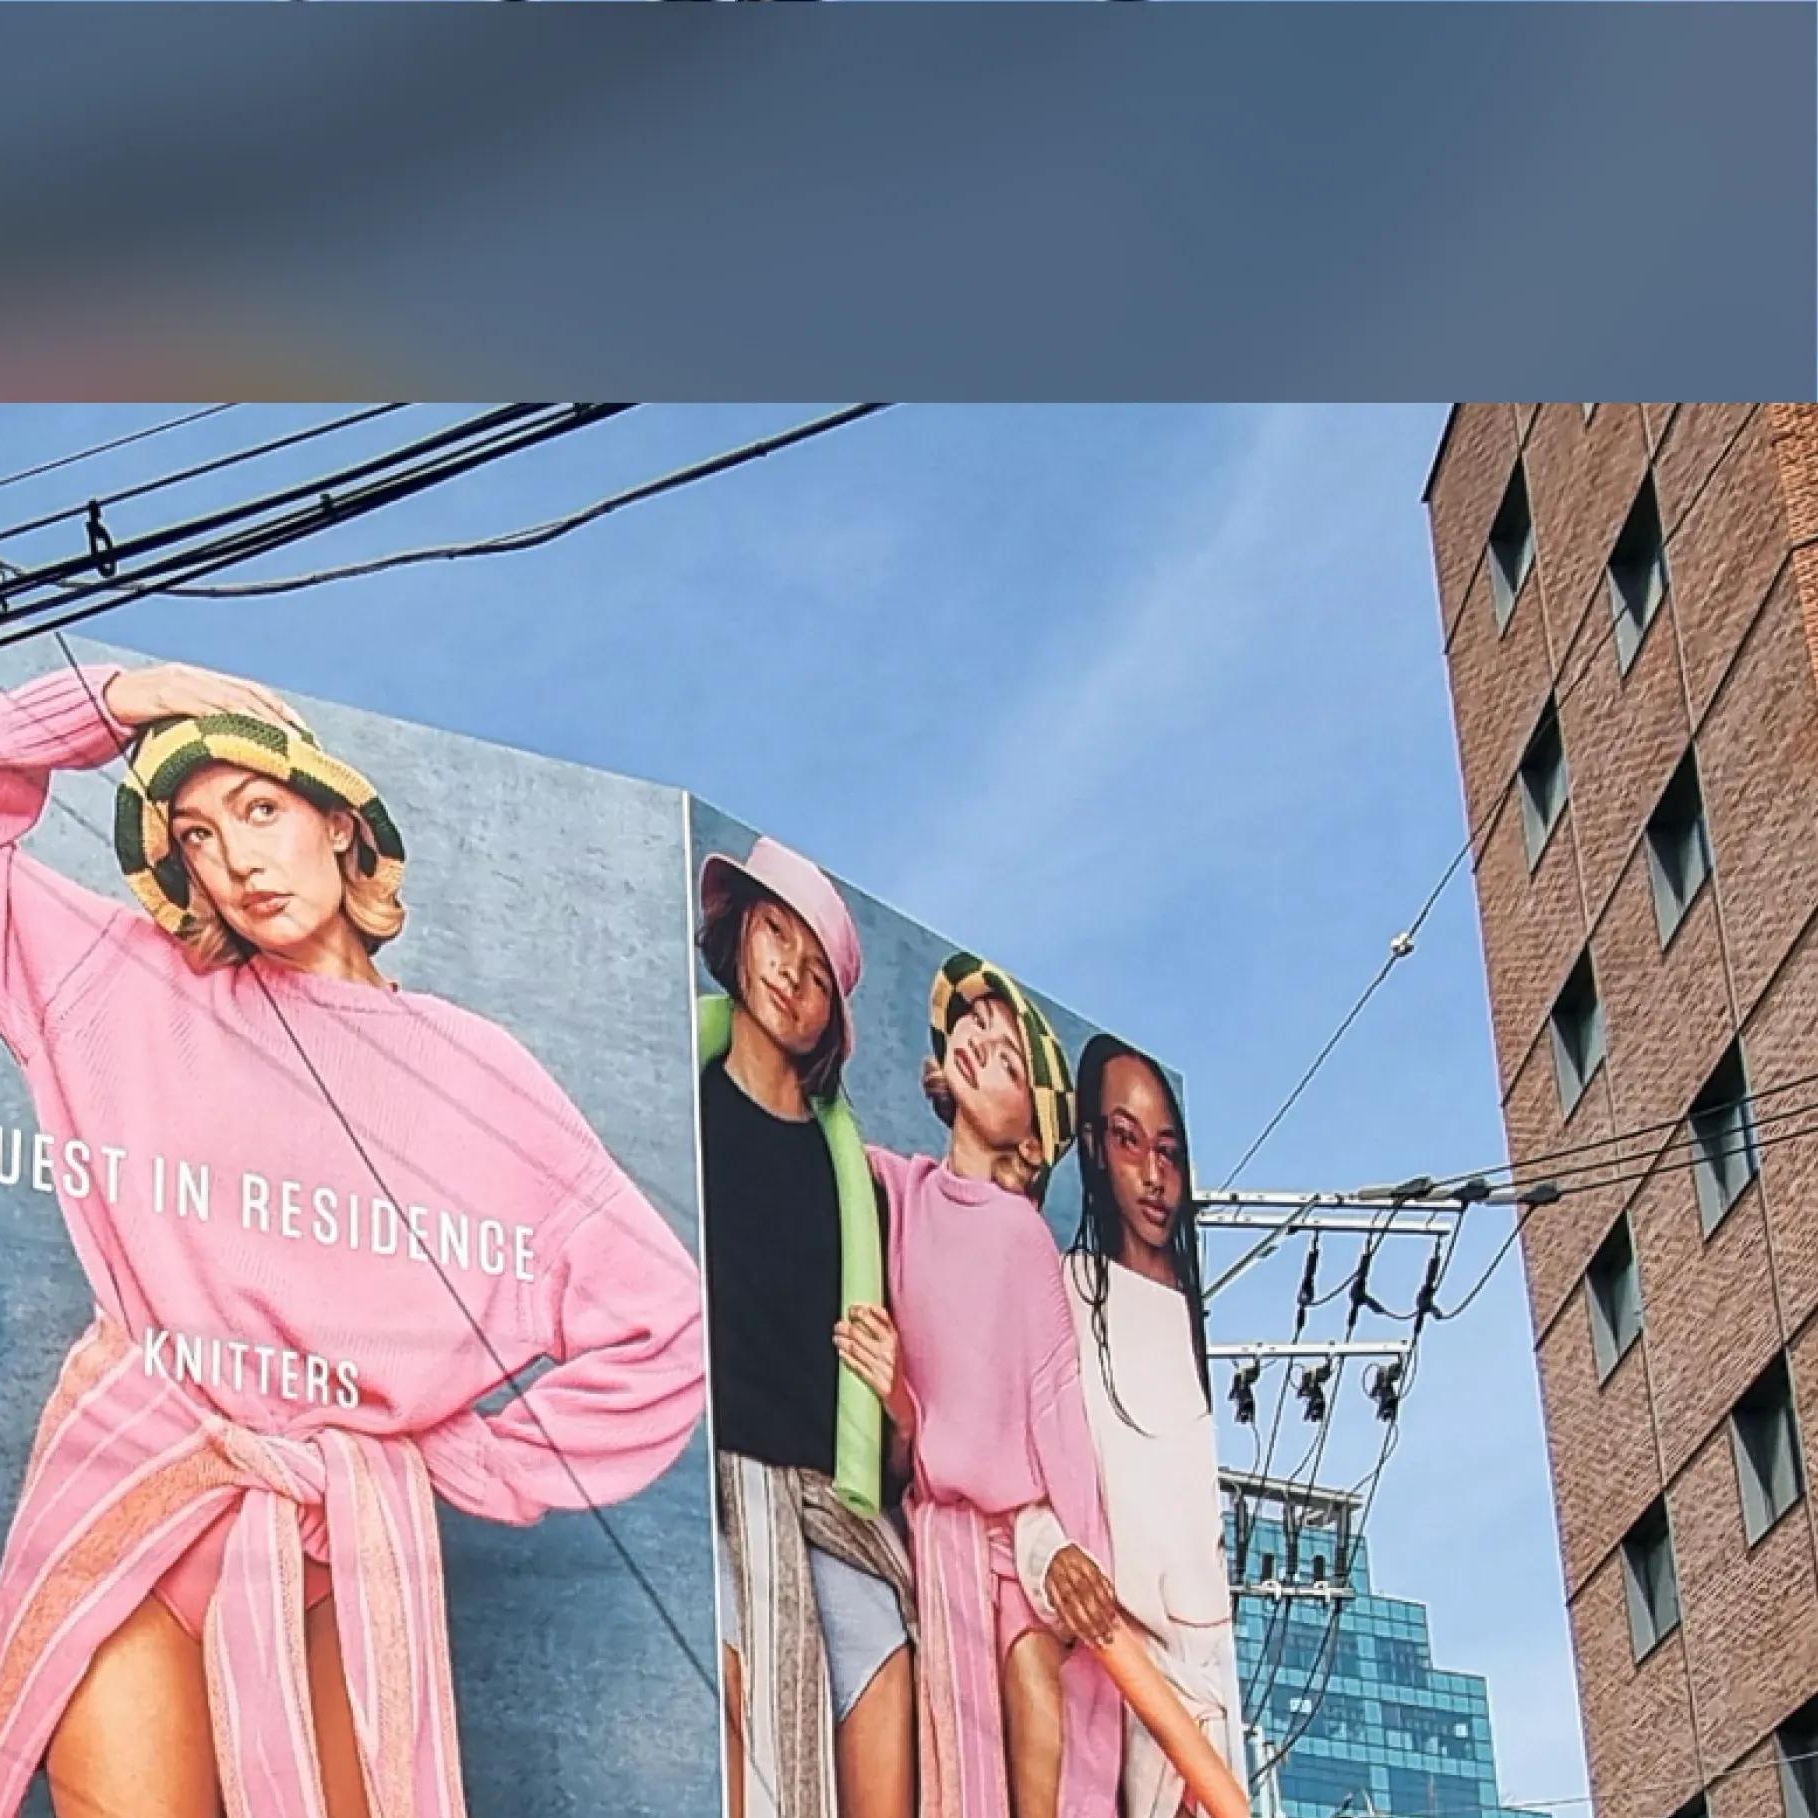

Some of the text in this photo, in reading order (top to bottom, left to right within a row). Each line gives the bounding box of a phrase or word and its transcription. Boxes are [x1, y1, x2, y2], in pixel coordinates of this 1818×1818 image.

[153, 1156, 209, 1223] IN
[241, 1172, 535, 1283] RESIDENCE
[143, 1328, 360, 1410] KNITTERS
